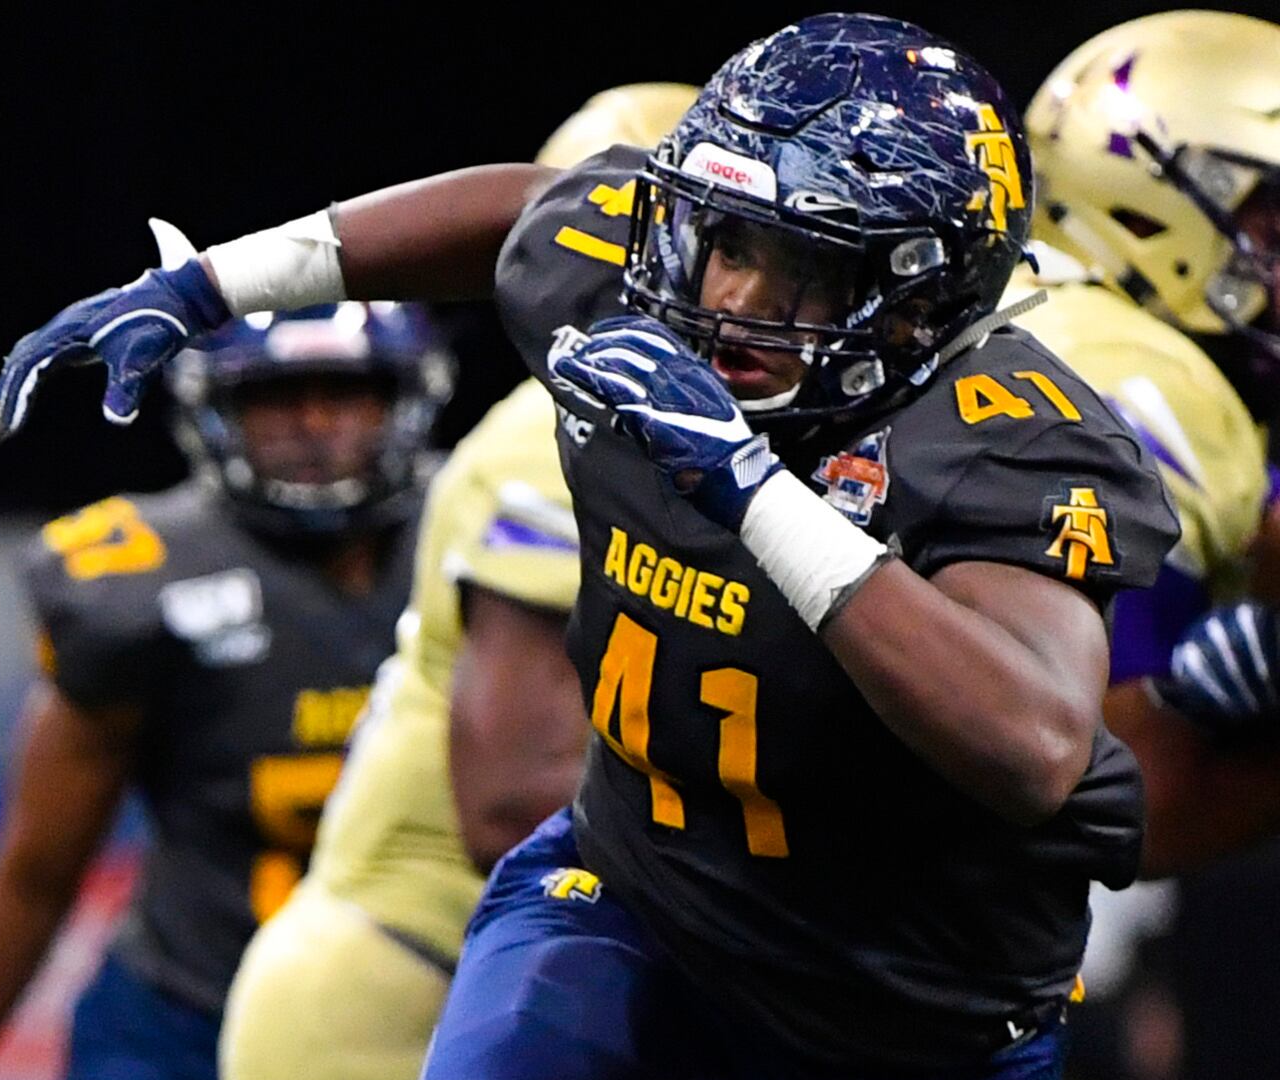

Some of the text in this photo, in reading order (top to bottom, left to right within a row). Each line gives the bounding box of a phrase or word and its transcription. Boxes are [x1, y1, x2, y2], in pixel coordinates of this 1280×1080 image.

[953, 370, 1084, 425] 41
[603, 526, 751, 637] AGGIES
[591, 611, 790, 858] 41
